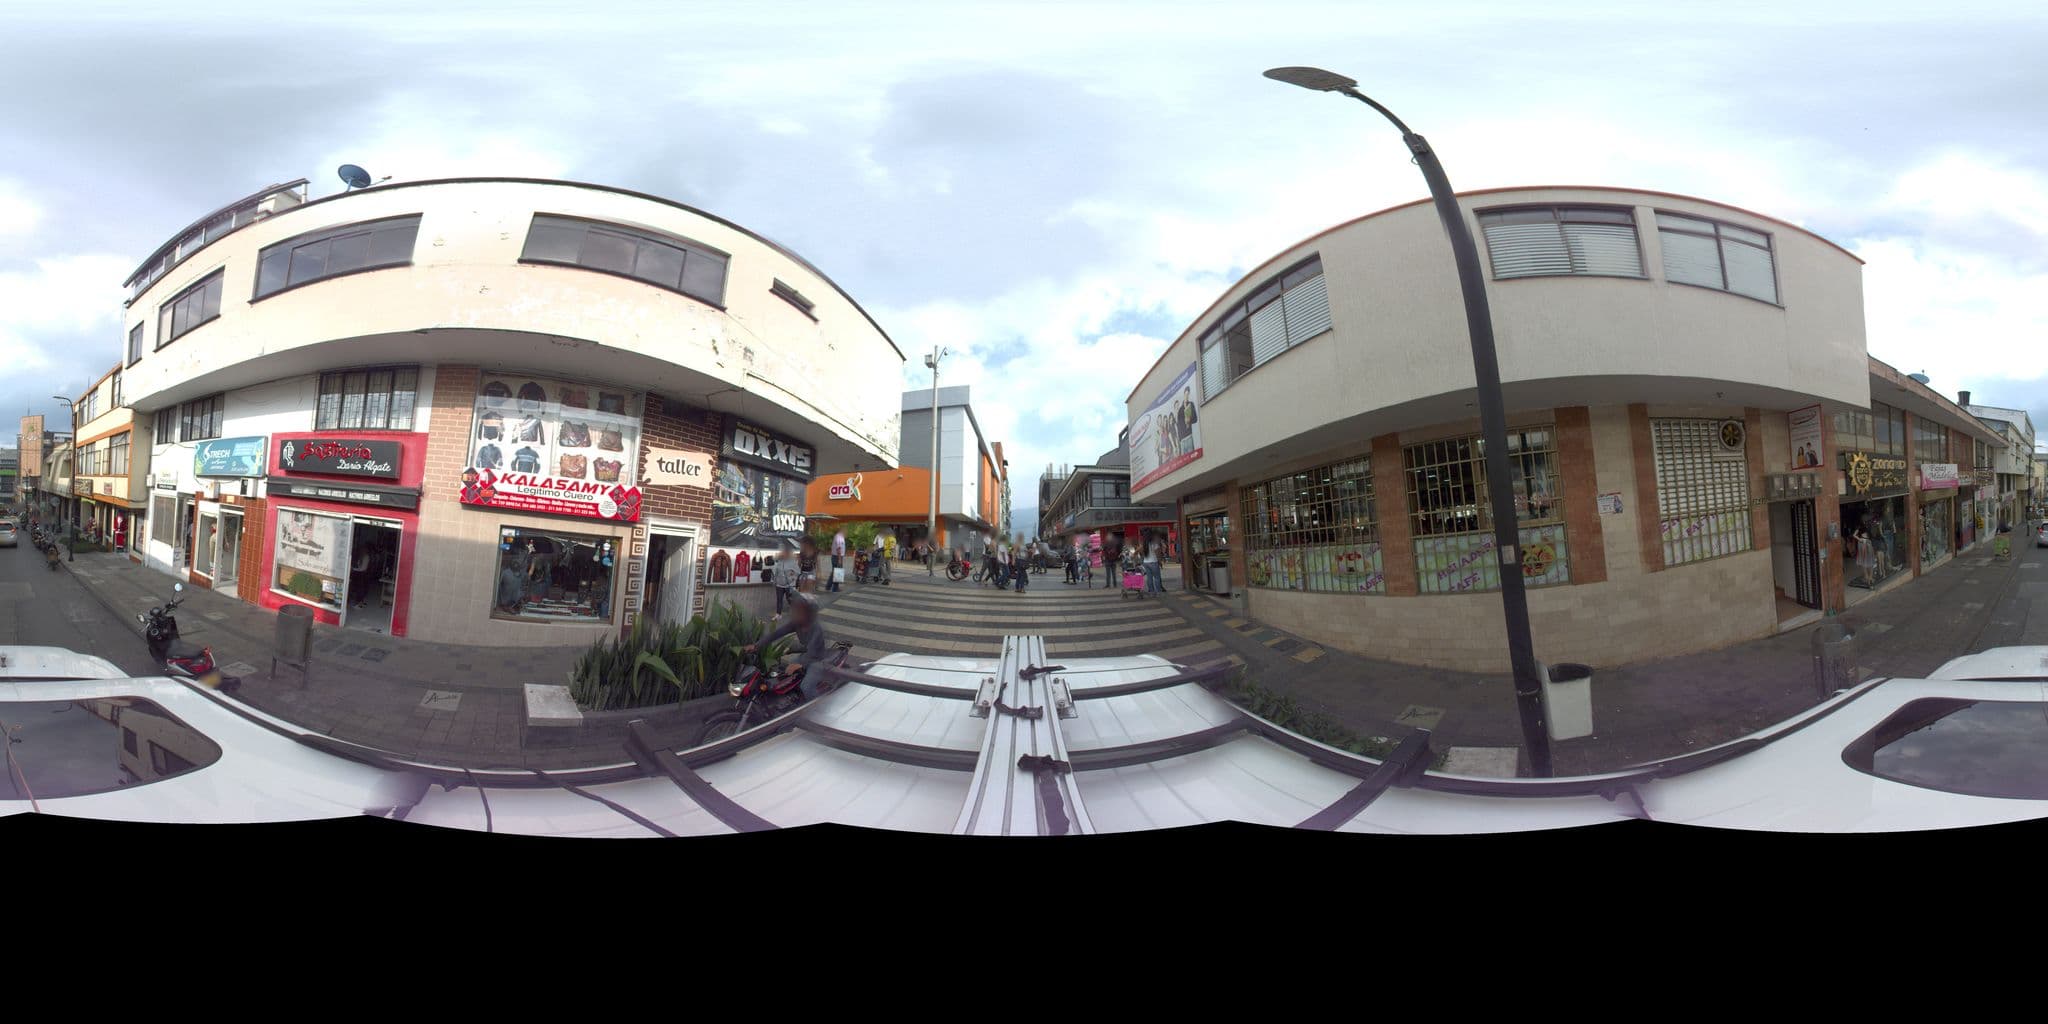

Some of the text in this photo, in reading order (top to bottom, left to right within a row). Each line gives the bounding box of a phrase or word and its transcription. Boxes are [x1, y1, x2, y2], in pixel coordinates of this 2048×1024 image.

[733, 428, 811, 468] OXXIS
[656, 456, 702, 477] taller
[500, 473, 611, 495] KALASAMY
[830, 485, 850, 495] ara
[563, 490, 594, 501] Cuero
[772, 513, 806, 532] OXXIS
